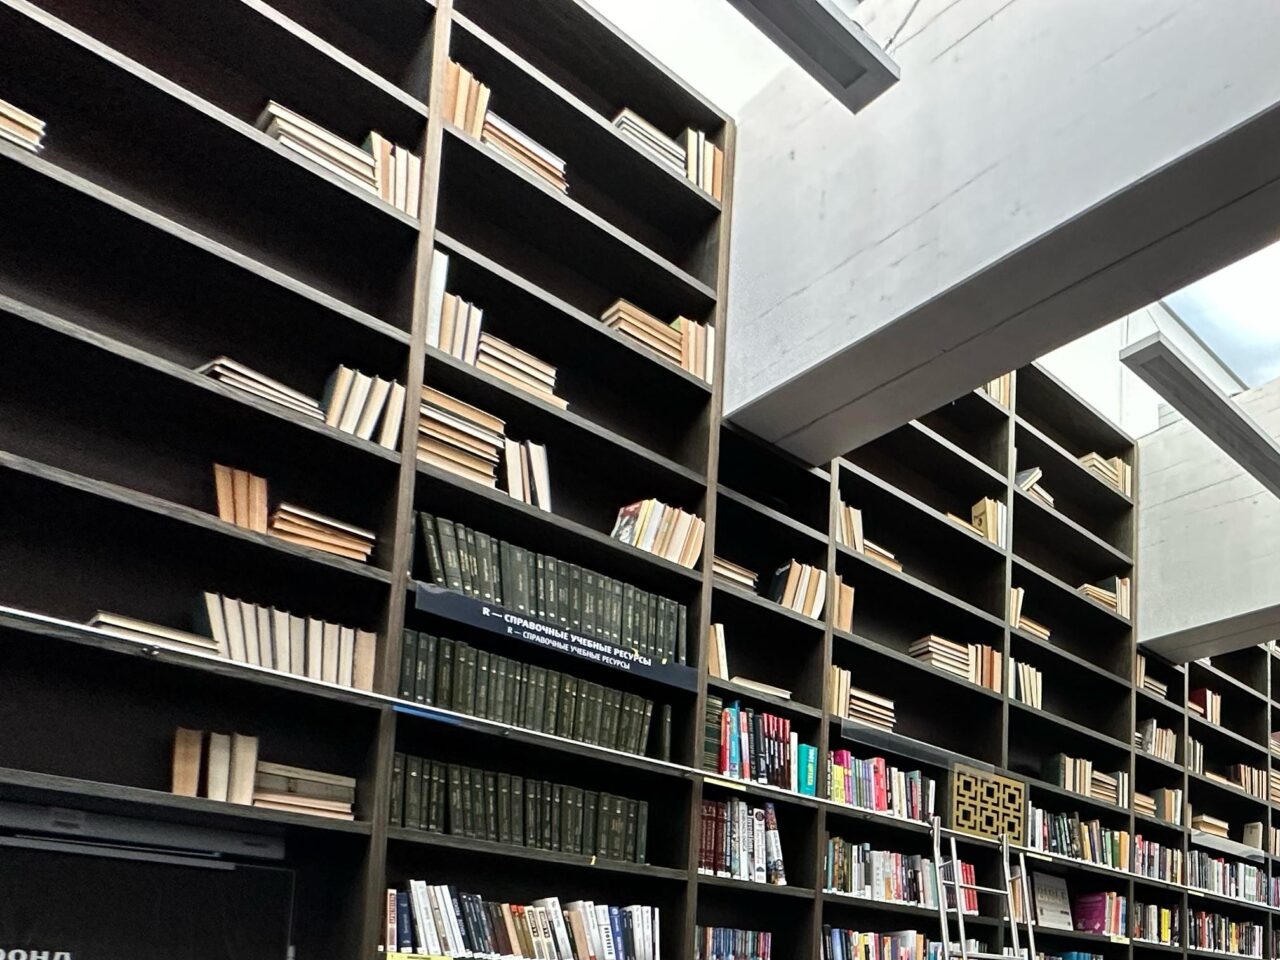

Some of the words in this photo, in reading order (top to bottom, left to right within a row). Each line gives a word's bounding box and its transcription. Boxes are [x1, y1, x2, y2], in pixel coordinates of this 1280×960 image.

[482, 606, 490, 617] R
[504, 613, 569, 641] СПРАВОЧНЫЕ
[570, 633, 613, 656] УЧЕБНЫЕ
[613, 647, 652, 667] РЕСУРСЫ
[522, 630, 569, 651] СПРАВОЧНЫЕ
[570, 645, 601, 661] УЧЕБНЫЕ
[601, 655, 631, 671] РЕСУРСЫ
